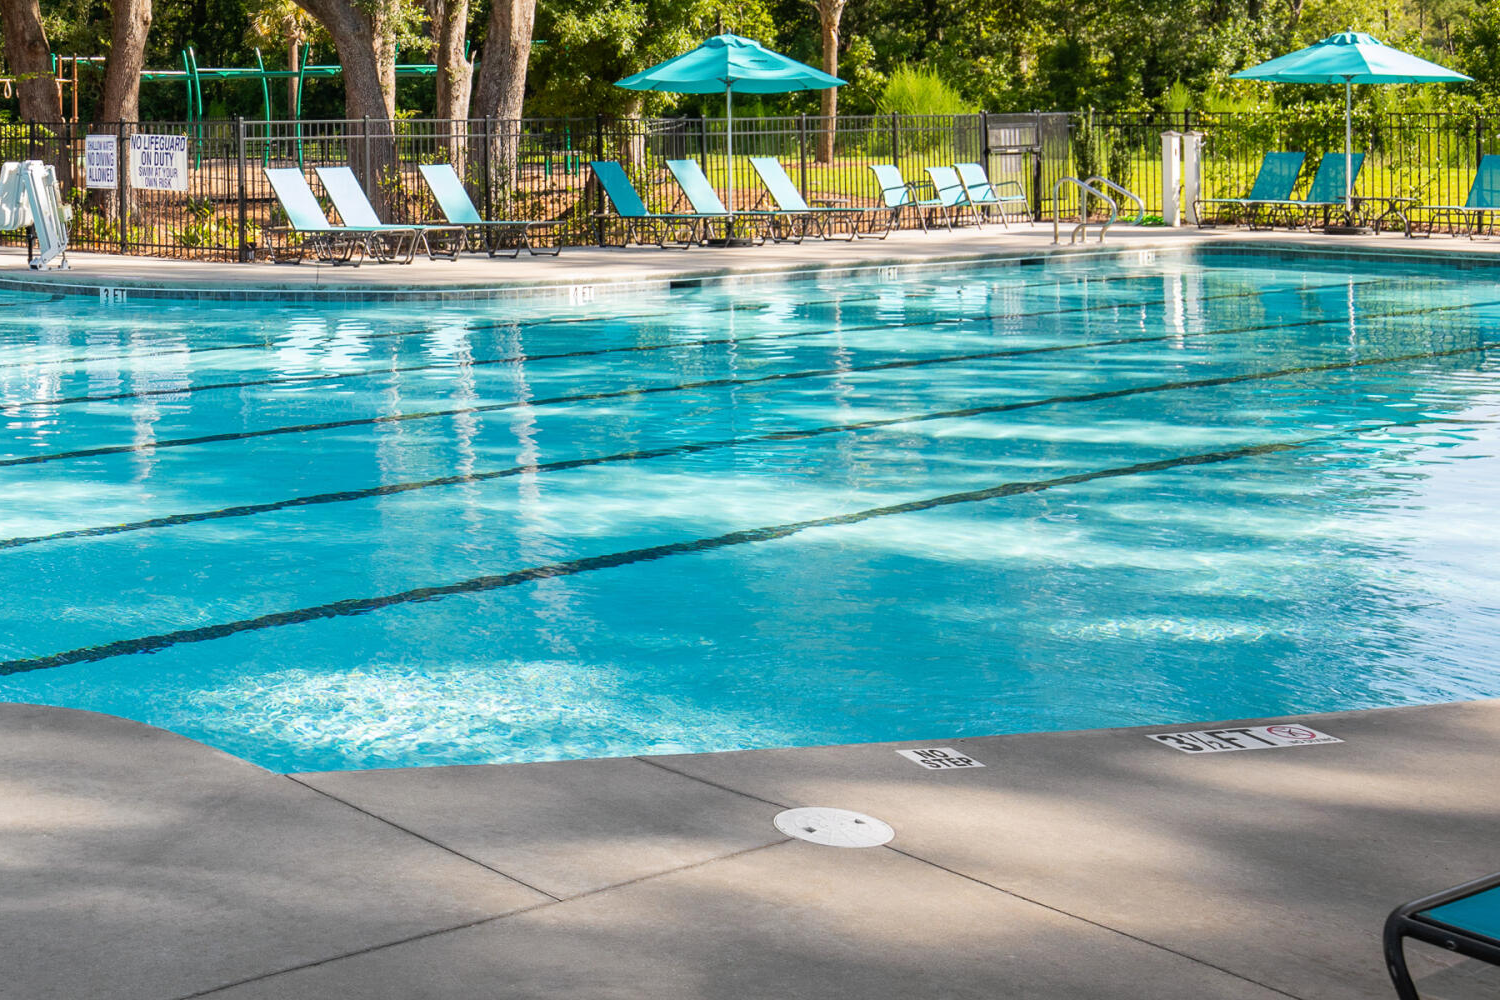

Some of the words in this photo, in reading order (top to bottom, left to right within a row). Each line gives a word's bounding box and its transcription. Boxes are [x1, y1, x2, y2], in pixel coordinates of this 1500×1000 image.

[131, 135, 141, 149] NO
[144, 135, 185, 151] LIFEGUARD
[88, 152, 95, 166] NO
[96, 152, 113, 166] DIVING
[141, 151, 152, 165] ON
[154, 151, 174, 166] DUTY
[89, 168, 114, 182] ALLOWED
[139, 166, 153, 176] SWIM
[155, 167, 161, 176] AT
[162, 168, 178, 178] YOUR
[145, 176, 157, 187] OWN
[159, 177, 172, 188] RISK
[912, 749, 949, 759] NO
[920, 757, 974, 768] STEP
